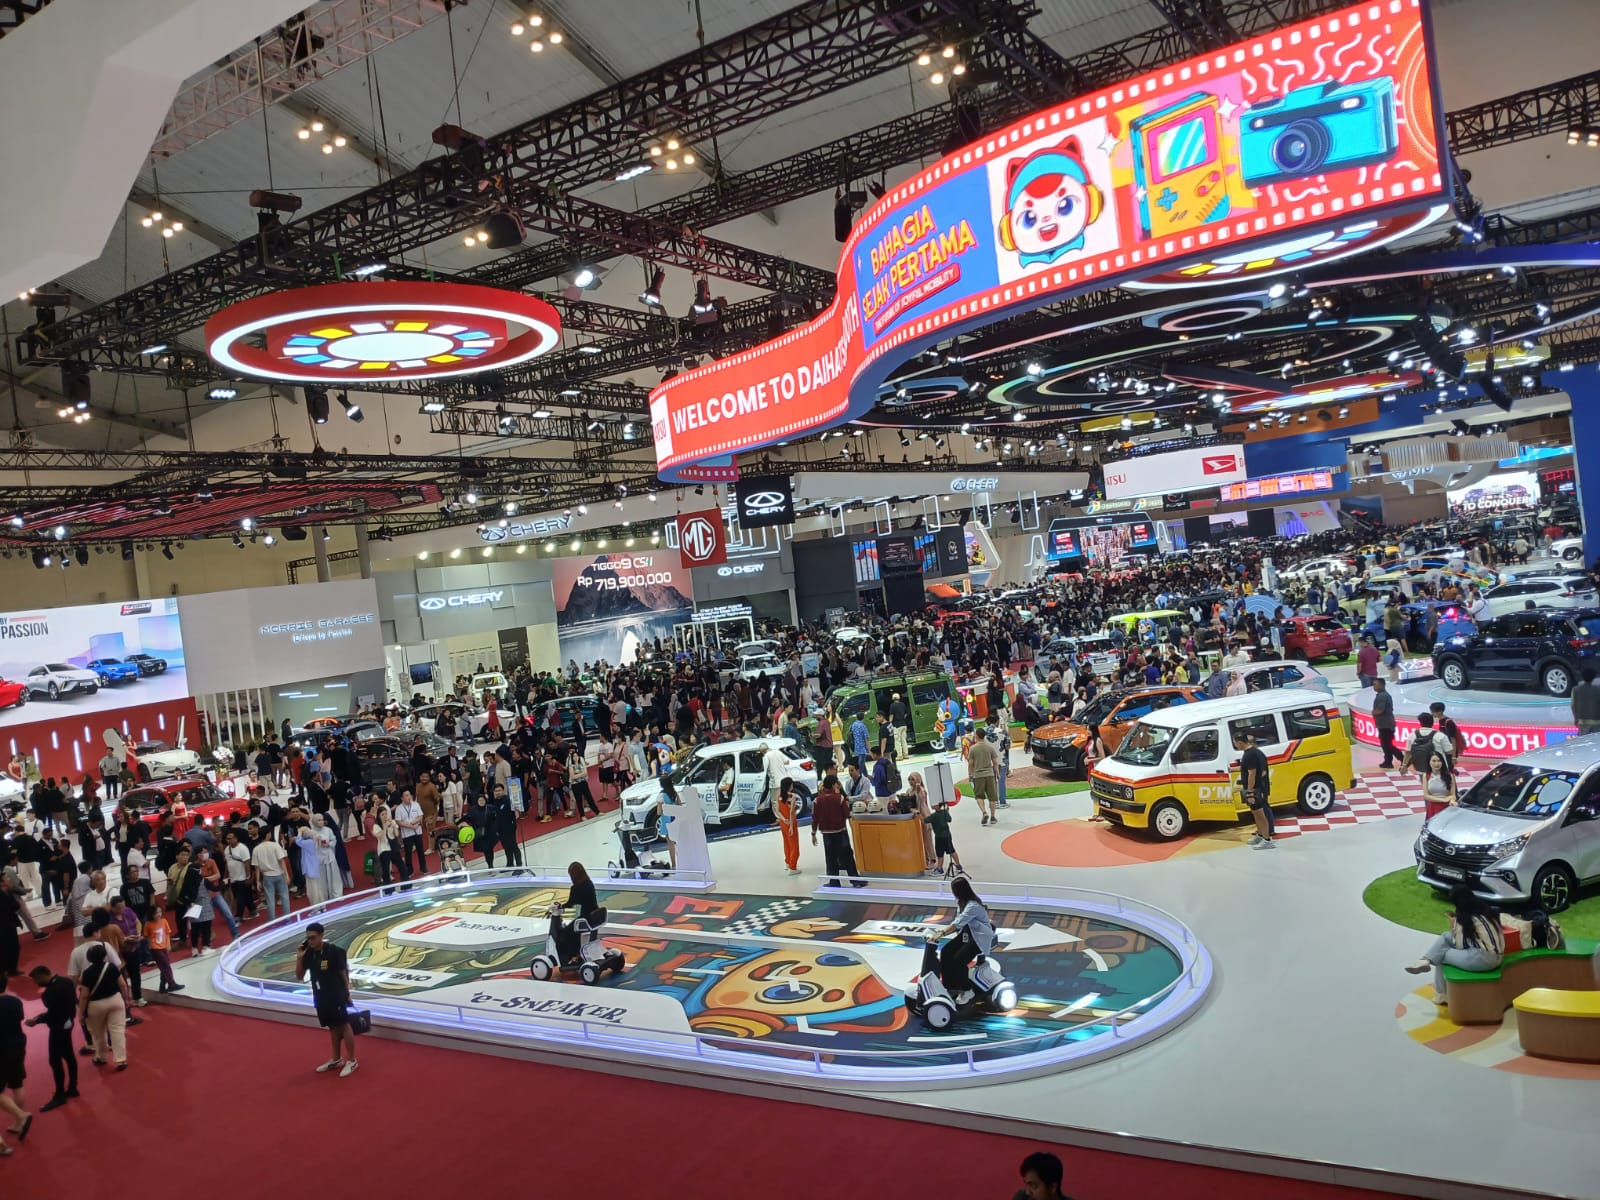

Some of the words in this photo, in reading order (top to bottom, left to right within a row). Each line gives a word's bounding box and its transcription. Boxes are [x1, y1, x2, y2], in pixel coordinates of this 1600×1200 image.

[871, 205, 936, 277] BAHAGIA
[862, 273, 890, 321] SEJAK
[890, 219, 977, 293] PERTAMA
[923, 268, 953, 292] MOBILITY
[672, 386, 768, 434] WELCOME
[770, 372, 796, 404] TO
[967, 478, 999, 489] CHERY
[745, 505, 786, 516] CHERY
[1462, 501, 1477, 511] TO
[1477, 496, 1530, 509] CONQUER
[509, 516, 574, 537] CHERY
[685, 521, 713, 556] MG
[733, 563, 764, 575] CHERY
[578, 576, 593, 588] Rp
[594, 572, 672, 591] 719,900,000
[448, 591, 504, 607] CHERY
[1, 622, 49, 639] PASSION
[260, 620, 314, 635] MORRIS
[318, 613, 375, 628] GARAGES
